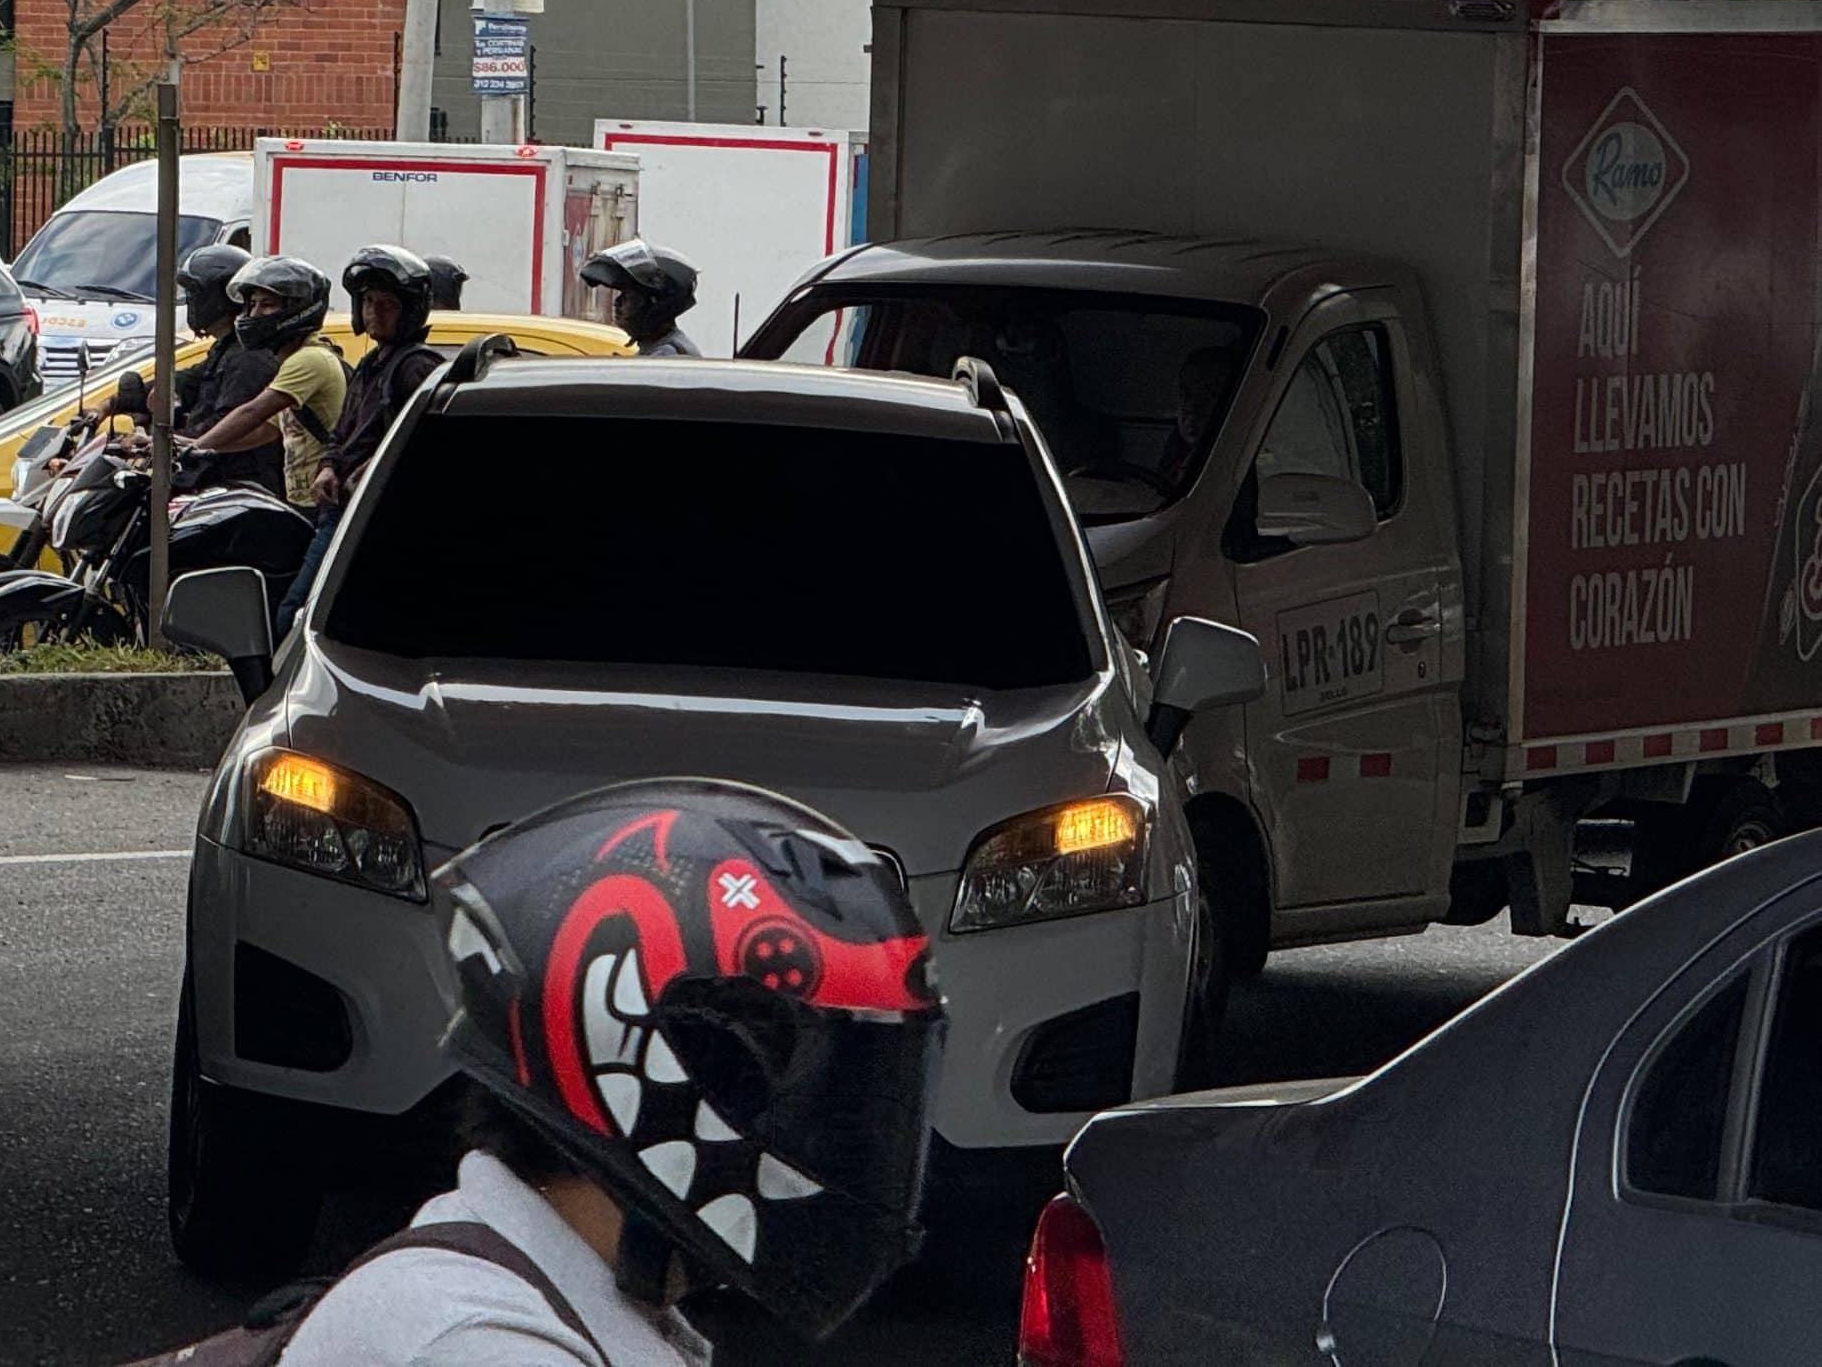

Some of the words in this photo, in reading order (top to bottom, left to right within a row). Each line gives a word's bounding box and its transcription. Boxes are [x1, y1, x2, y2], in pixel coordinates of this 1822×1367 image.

[372, 172, 438, 183] BENFOR
[1592, 131, 1663, 205] Ramo
[1577, 265, 1642, 359] AQUÍ
[1573, 371, 1715, 455] LLEVAMOS
[1570, 468, 1691, 550] RECETAS
[1695, 462, 1747, 541] CON
[1568, 553, 1694, 651] CORAZÓN
